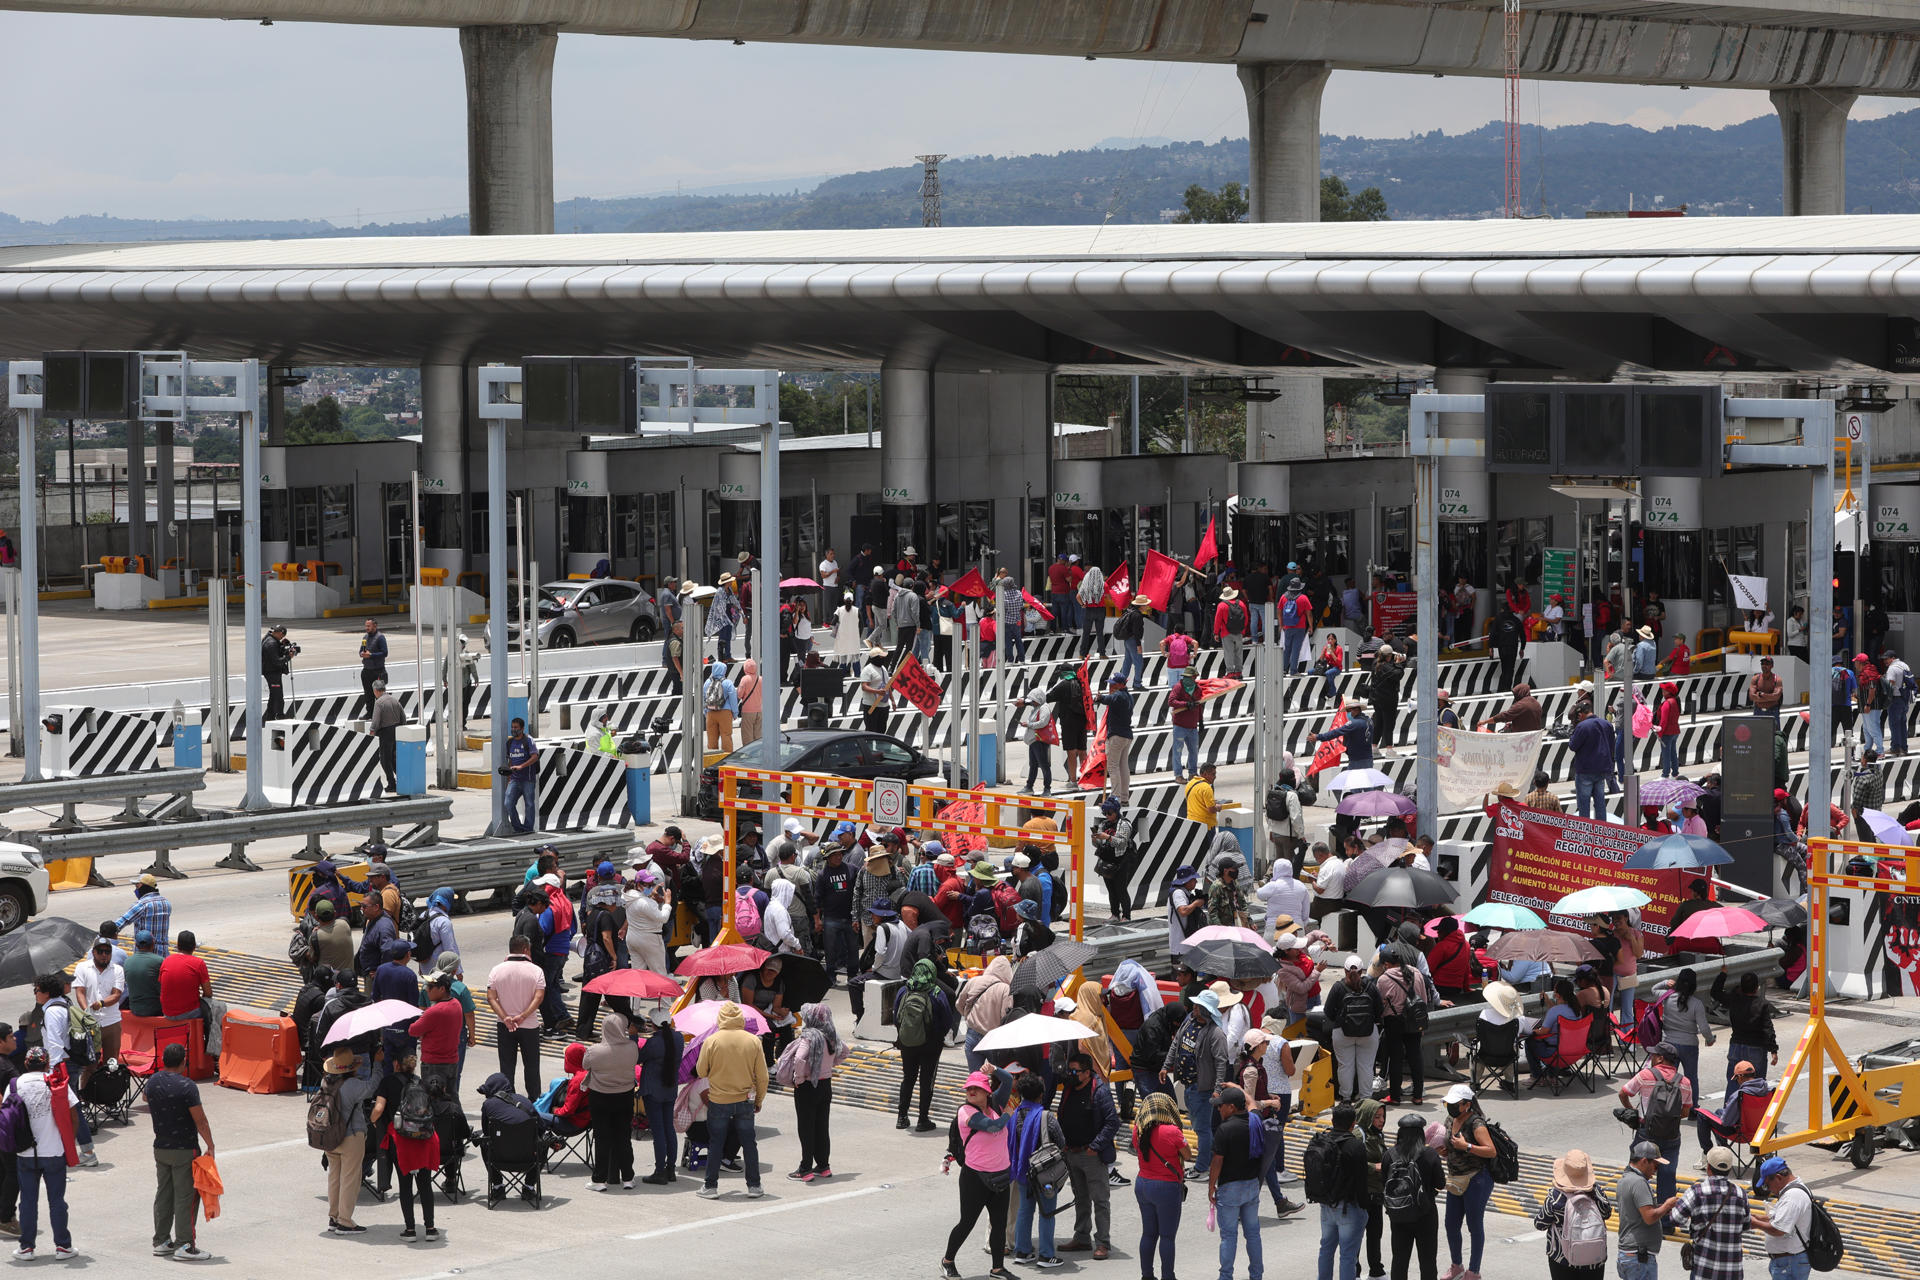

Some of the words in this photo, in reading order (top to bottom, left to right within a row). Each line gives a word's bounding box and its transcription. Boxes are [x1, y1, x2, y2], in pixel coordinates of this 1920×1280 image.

[424, 479, 444, 487] 074
[568, 480, 589, 489] 074
[721, 484, 744, 493] 074
[884, 488, 908, 497] 074
[1055, 492, 1081, 502] 074
[1444, 489, 1461, 498] 074
[1241, 497, 1268, 507] 074
[1655, 497, 1672, 506] 074
[1439, 503, 1469, 514] 074
[1881, 507, 1899, 516] 074
[1648, 511, 1679, 522] 074
[1876, 521, 1910, 533] 074
[1733, 576, 1759, 608] PREESCOLAR
[1520, 810, 1567, 828] COORDINADORA
[1568, 820, 1593, 835] ESTATAL
[1594, 824, 1603, 835] DE
[1604, 827, 1616, 837] LOS
[1617, 829, 1656, 843] TRABAJADO
[1594, 836, 1604, 846] EN
[1604, 838, 1638, 853] GUERRERO
[1555, 839, 1591, 856] REGIÓN
[1593, 848, 1624, 863] COSTA
[1513, 864, 1559, 879] ABROGACIÓN
[1560, 873, 1570, 881] DE
[1571, 875, 1580, 884] LA
[1515, 851, 1560, 866] ABROGACIÓN
[1562, 860, 1572, 869] DE
[1573, 862, 1582, 870] LA
[1584, 865, 1597, 873] LEY
[1599, 868, 1612, 877] DEL
[1614, 870, 1639, 883] ISSSTE
[1641, 876, 1658, 886] 2007
[829, 873, 847, 883] ITALY
[1491, 889, 1544, 910] DELEGACIÓN
[1512, 876, 1546, 889] AUMENTO
[1647, 905, 1667, 915] BASE
